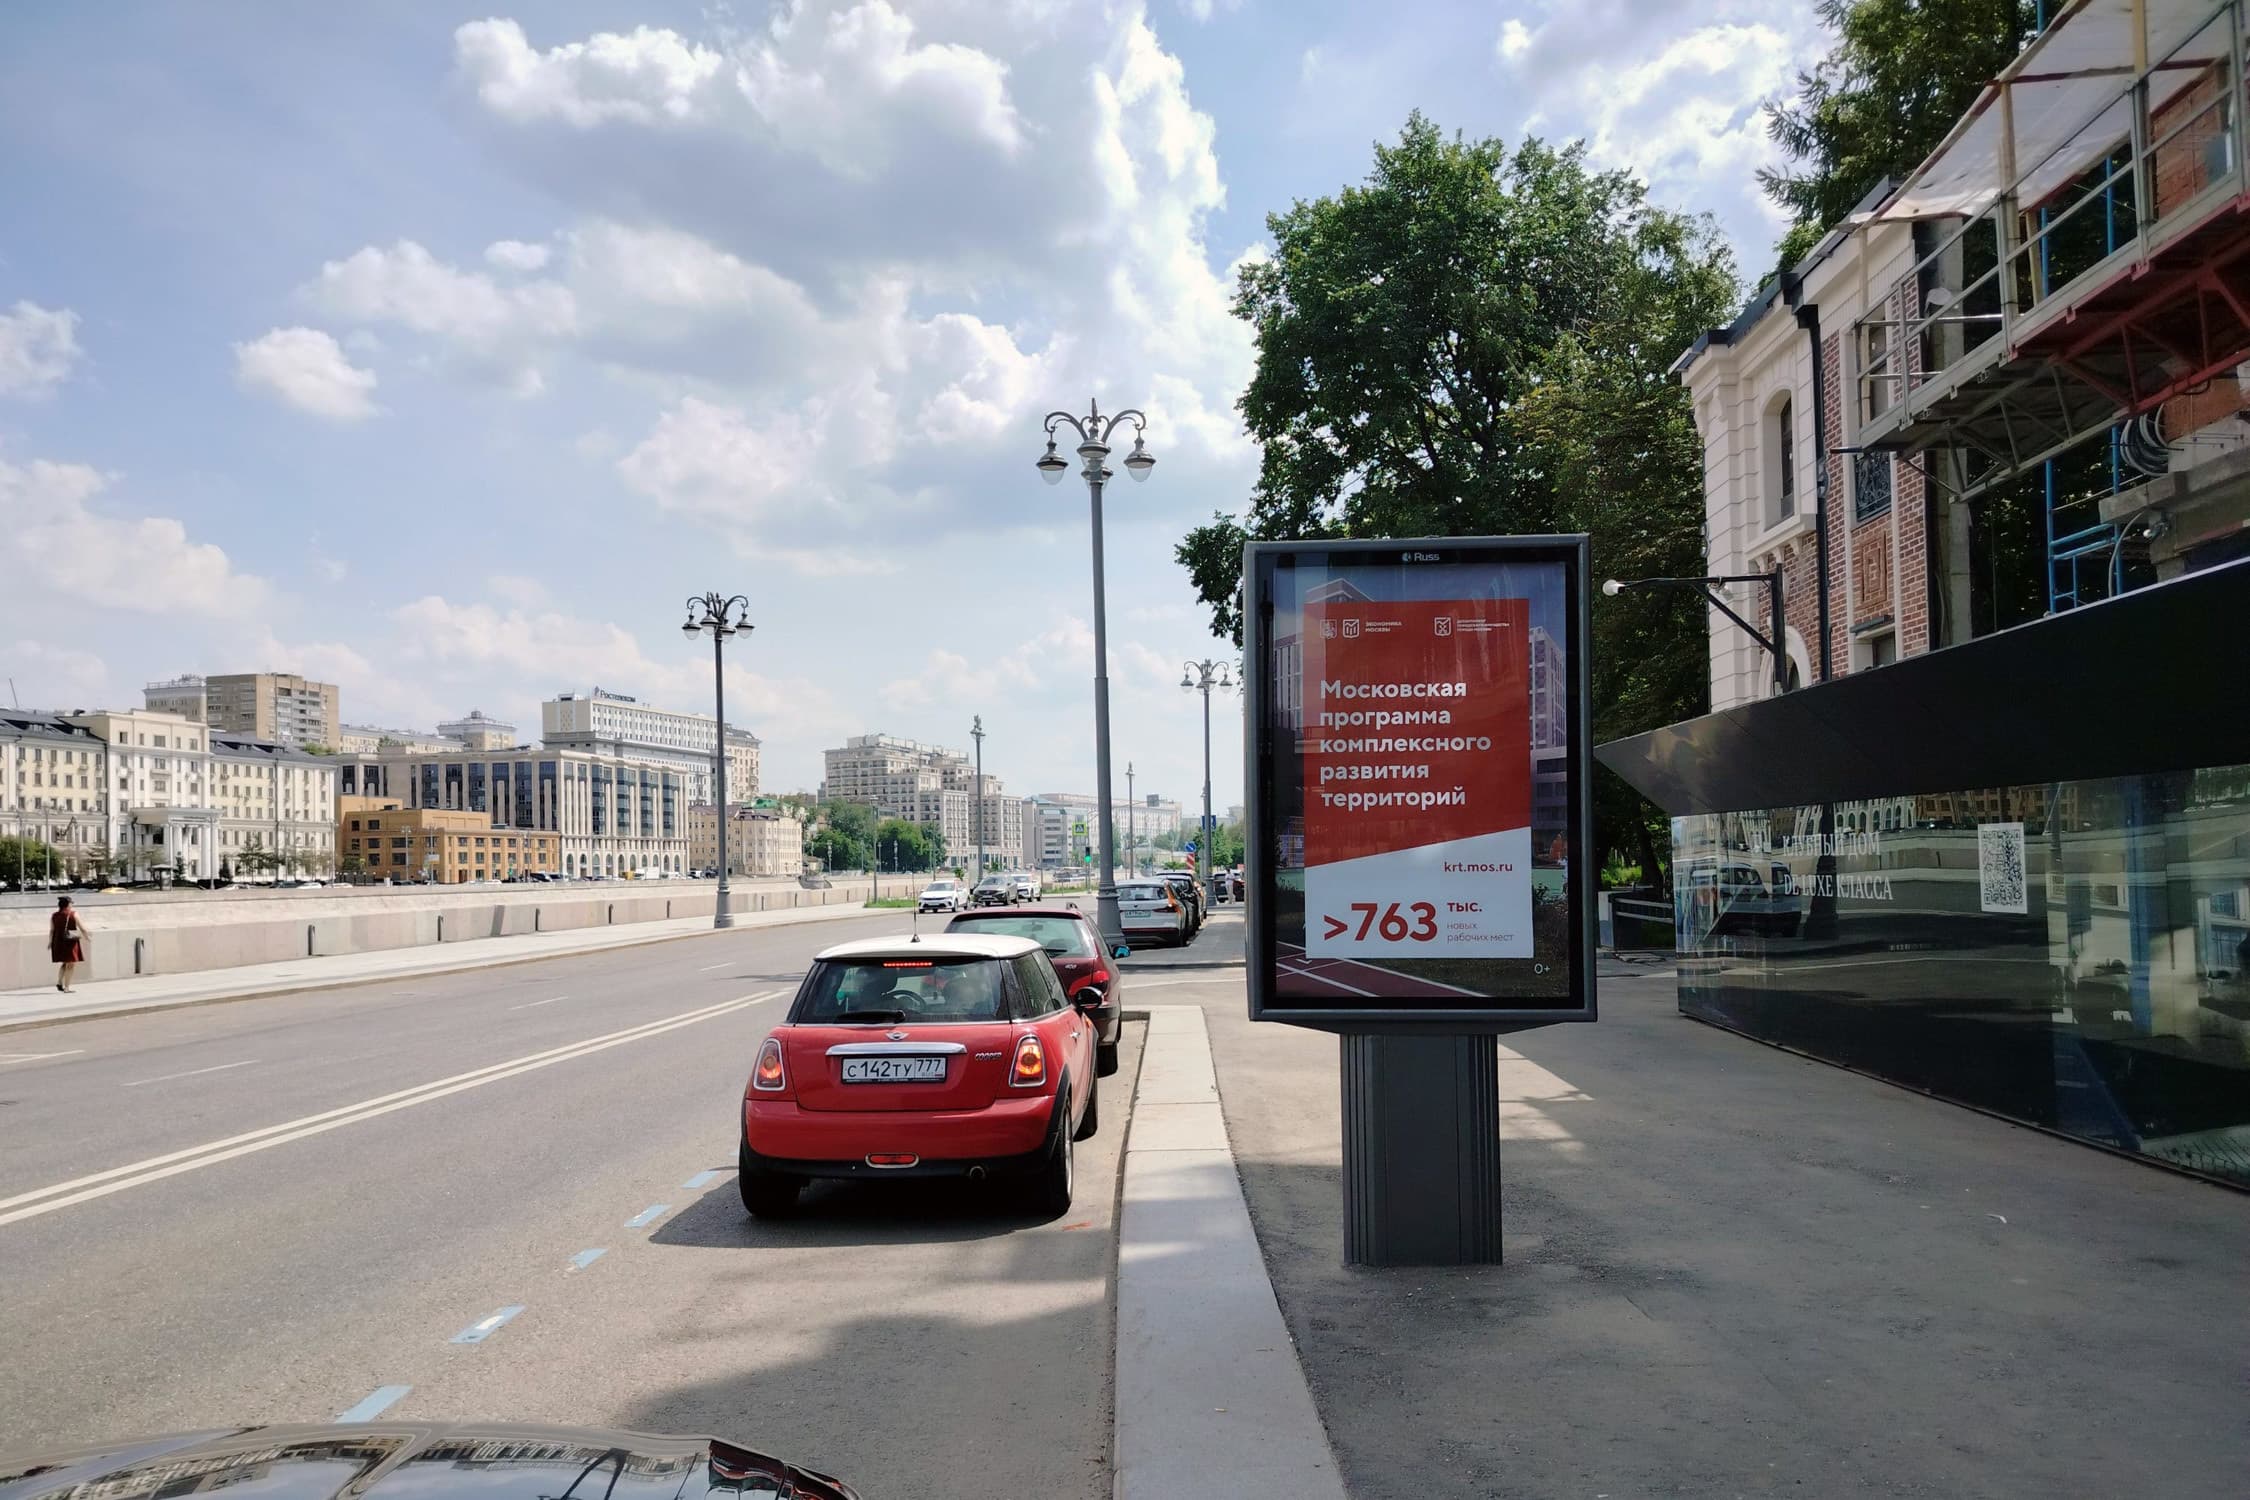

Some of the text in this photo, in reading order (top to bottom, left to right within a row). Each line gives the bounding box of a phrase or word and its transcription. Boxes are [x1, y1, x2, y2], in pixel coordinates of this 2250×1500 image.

[1414, 552, 1440, 562] Russ
[1320, 680, 1467, 699] Московская
[1320, 709, 1451, 730] программа
[1320, 735, 1491, 754] комплексного
[1320, 763, 1429, 785] развития
[1321, 786, 1466, 811] территорий
[1783, 831, 1881, 861] КЛУБНЫЙ ДОМ
[1444, 861, 1513, 874] krt.mos.ru
[1802, 874, 1833, 897] LUXE
[1836, 875, 1894, 900] КЛАССА
[1447, 902, 1483, 913] тыс.
[1446, 922, 1478, 931] новых
[1446, 932, 1514, 944] рабочих мест
